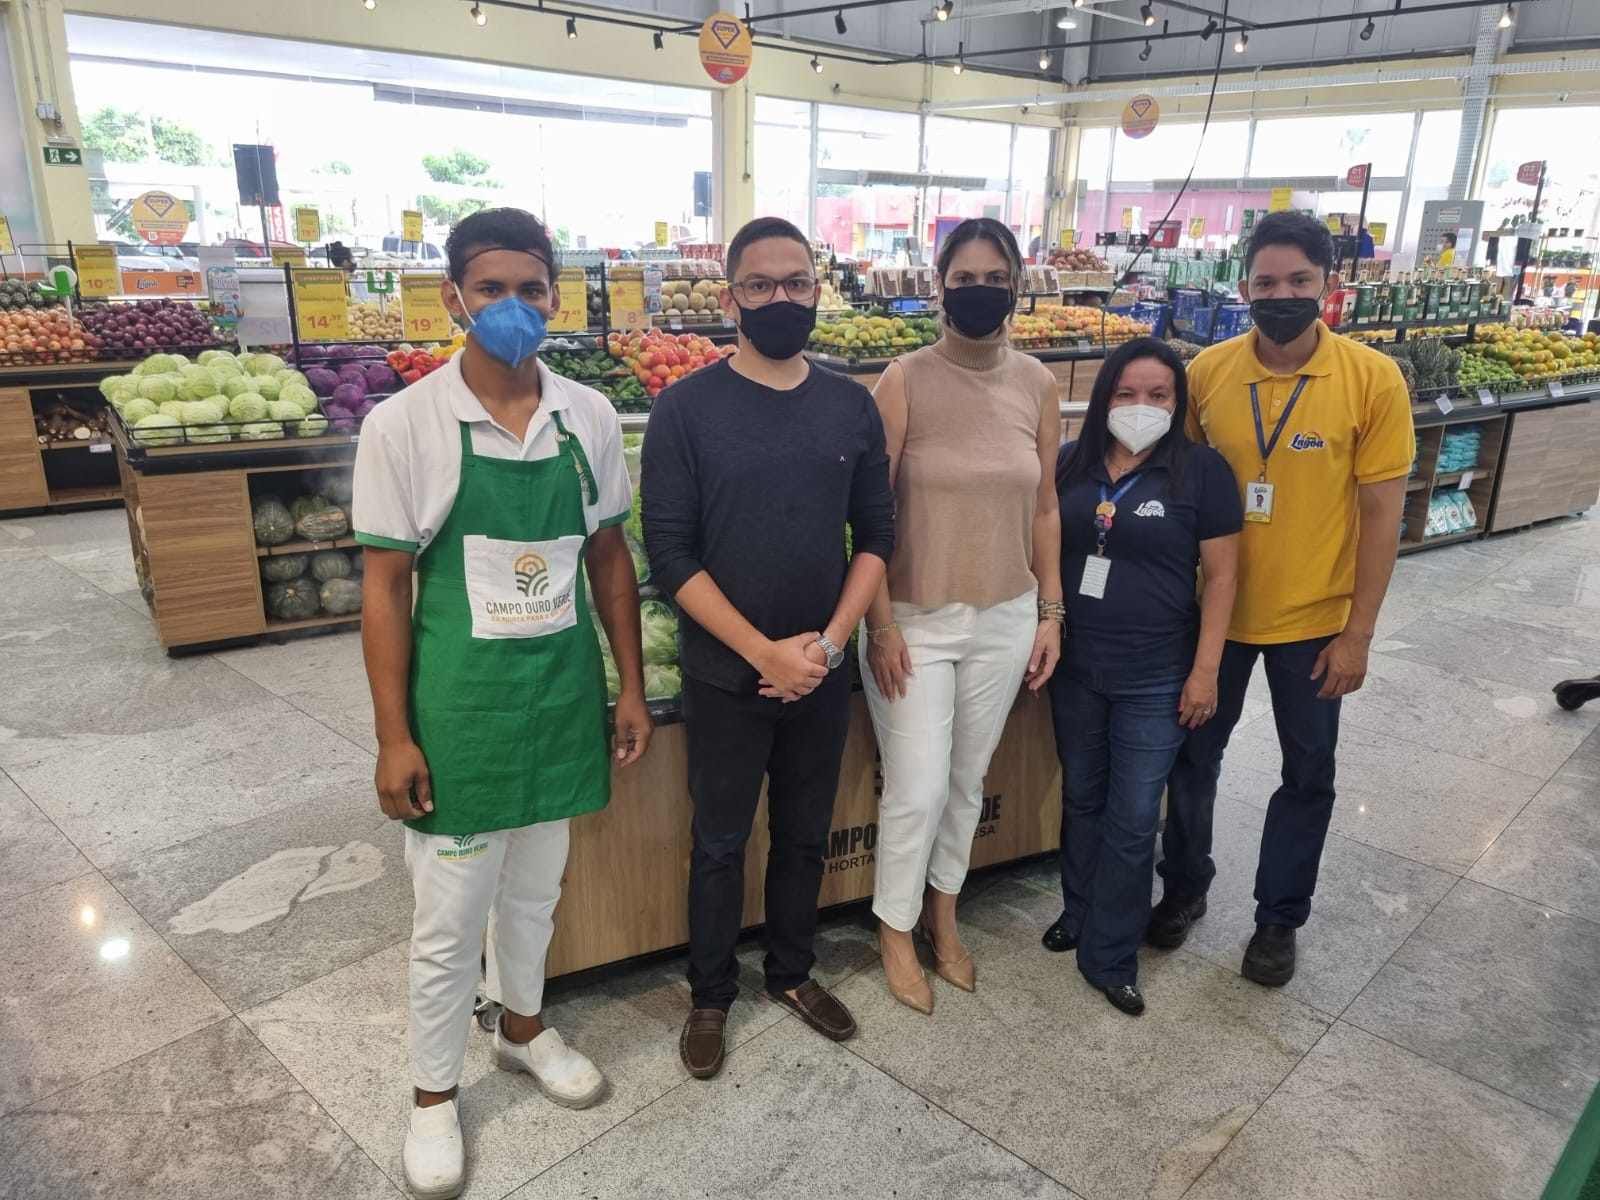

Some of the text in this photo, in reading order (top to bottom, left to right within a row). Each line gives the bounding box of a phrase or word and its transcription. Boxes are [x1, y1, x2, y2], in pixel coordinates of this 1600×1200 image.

[1290, 433, 1324, 450] Lagoa
[1133, 502, 1165, 518] Lagoa
[486, 601, 523, 615] CAMPO
[525, 600, 551, 614] OURO
[437, 849, 457, 857] CAMPO
[828, 853, 876, 874] HORTA
